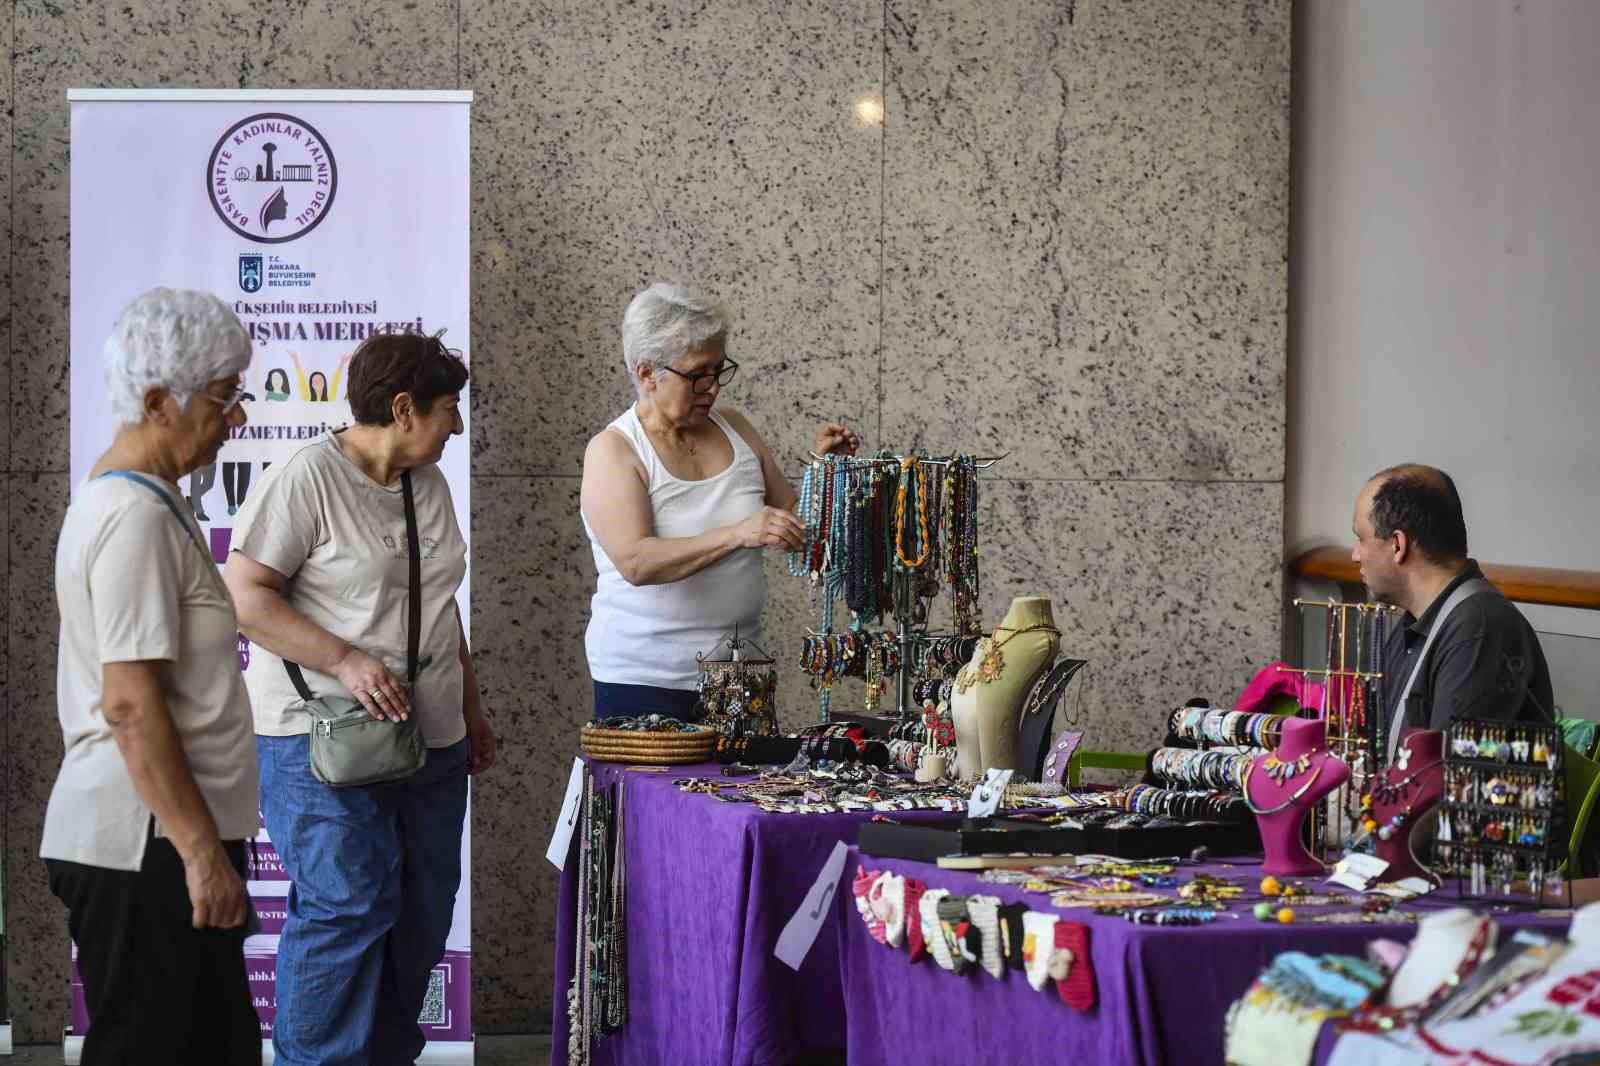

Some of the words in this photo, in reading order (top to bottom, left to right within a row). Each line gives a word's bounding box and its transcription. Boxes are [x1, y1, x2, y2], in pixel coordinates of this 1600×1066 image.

[233, 122, 302, 146] KADINLAR
[304, 137, 329, 186] YALNIZ
[298, 300, 377, 314] BELEDİYESİ
[244, 321, 308, 346] IŞMA
